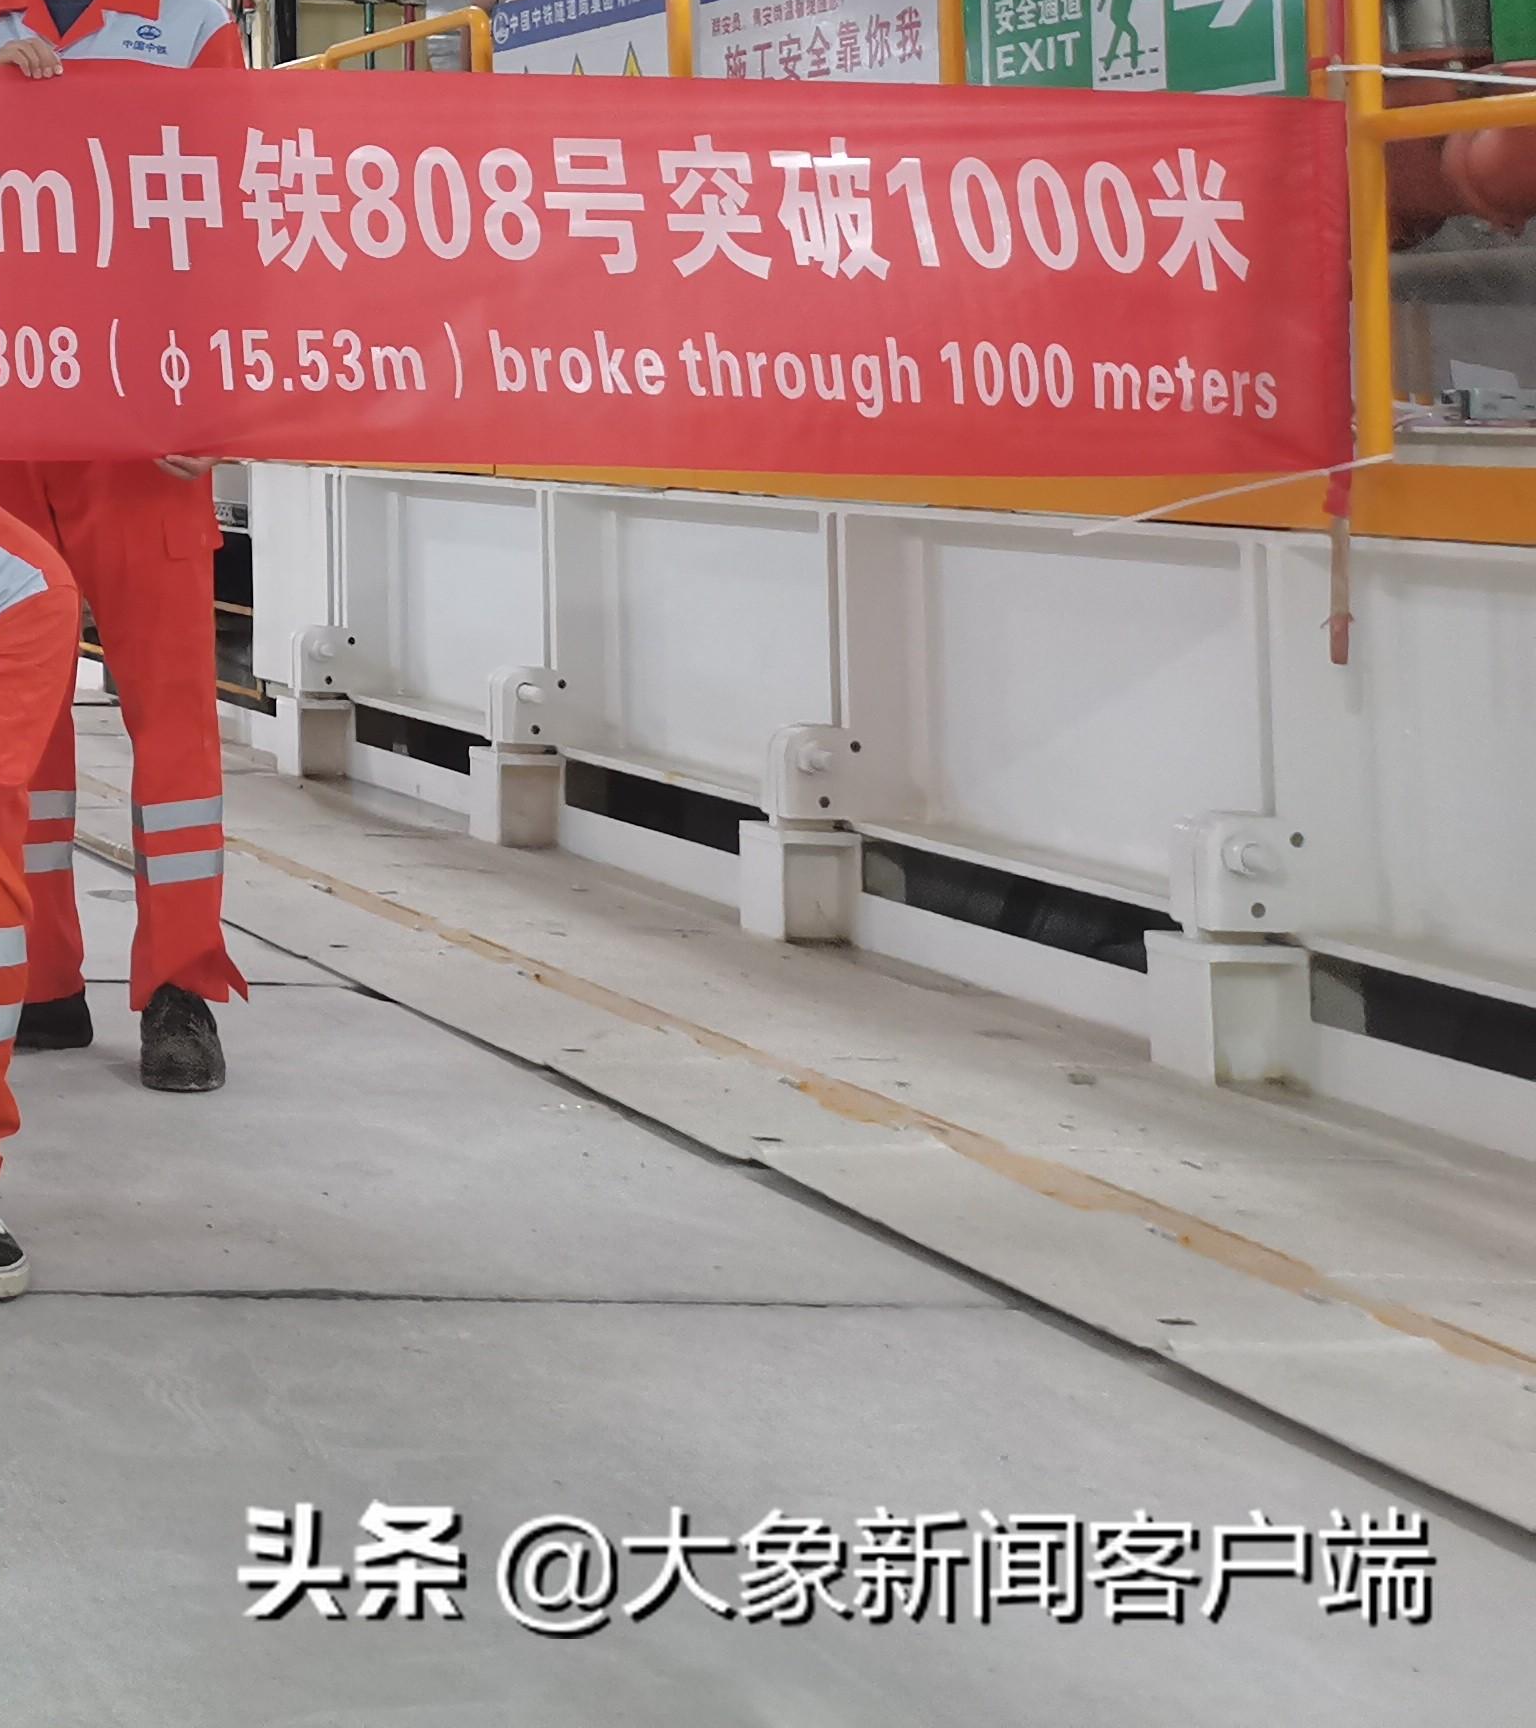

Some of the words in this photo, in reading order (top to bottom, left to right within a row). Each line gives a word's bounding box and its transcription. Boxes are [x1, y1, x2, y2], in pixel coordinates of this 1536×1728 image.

[724, 5, 924, 80] 施工安全靠你我
[995, 32, 1081, 81] EXIT
[487, 329, 666, 396] broke
[678, 330, 923, 419] through
[939, 340, 1075, 409] 1000
[1092, 356, 1278, 420] meters
